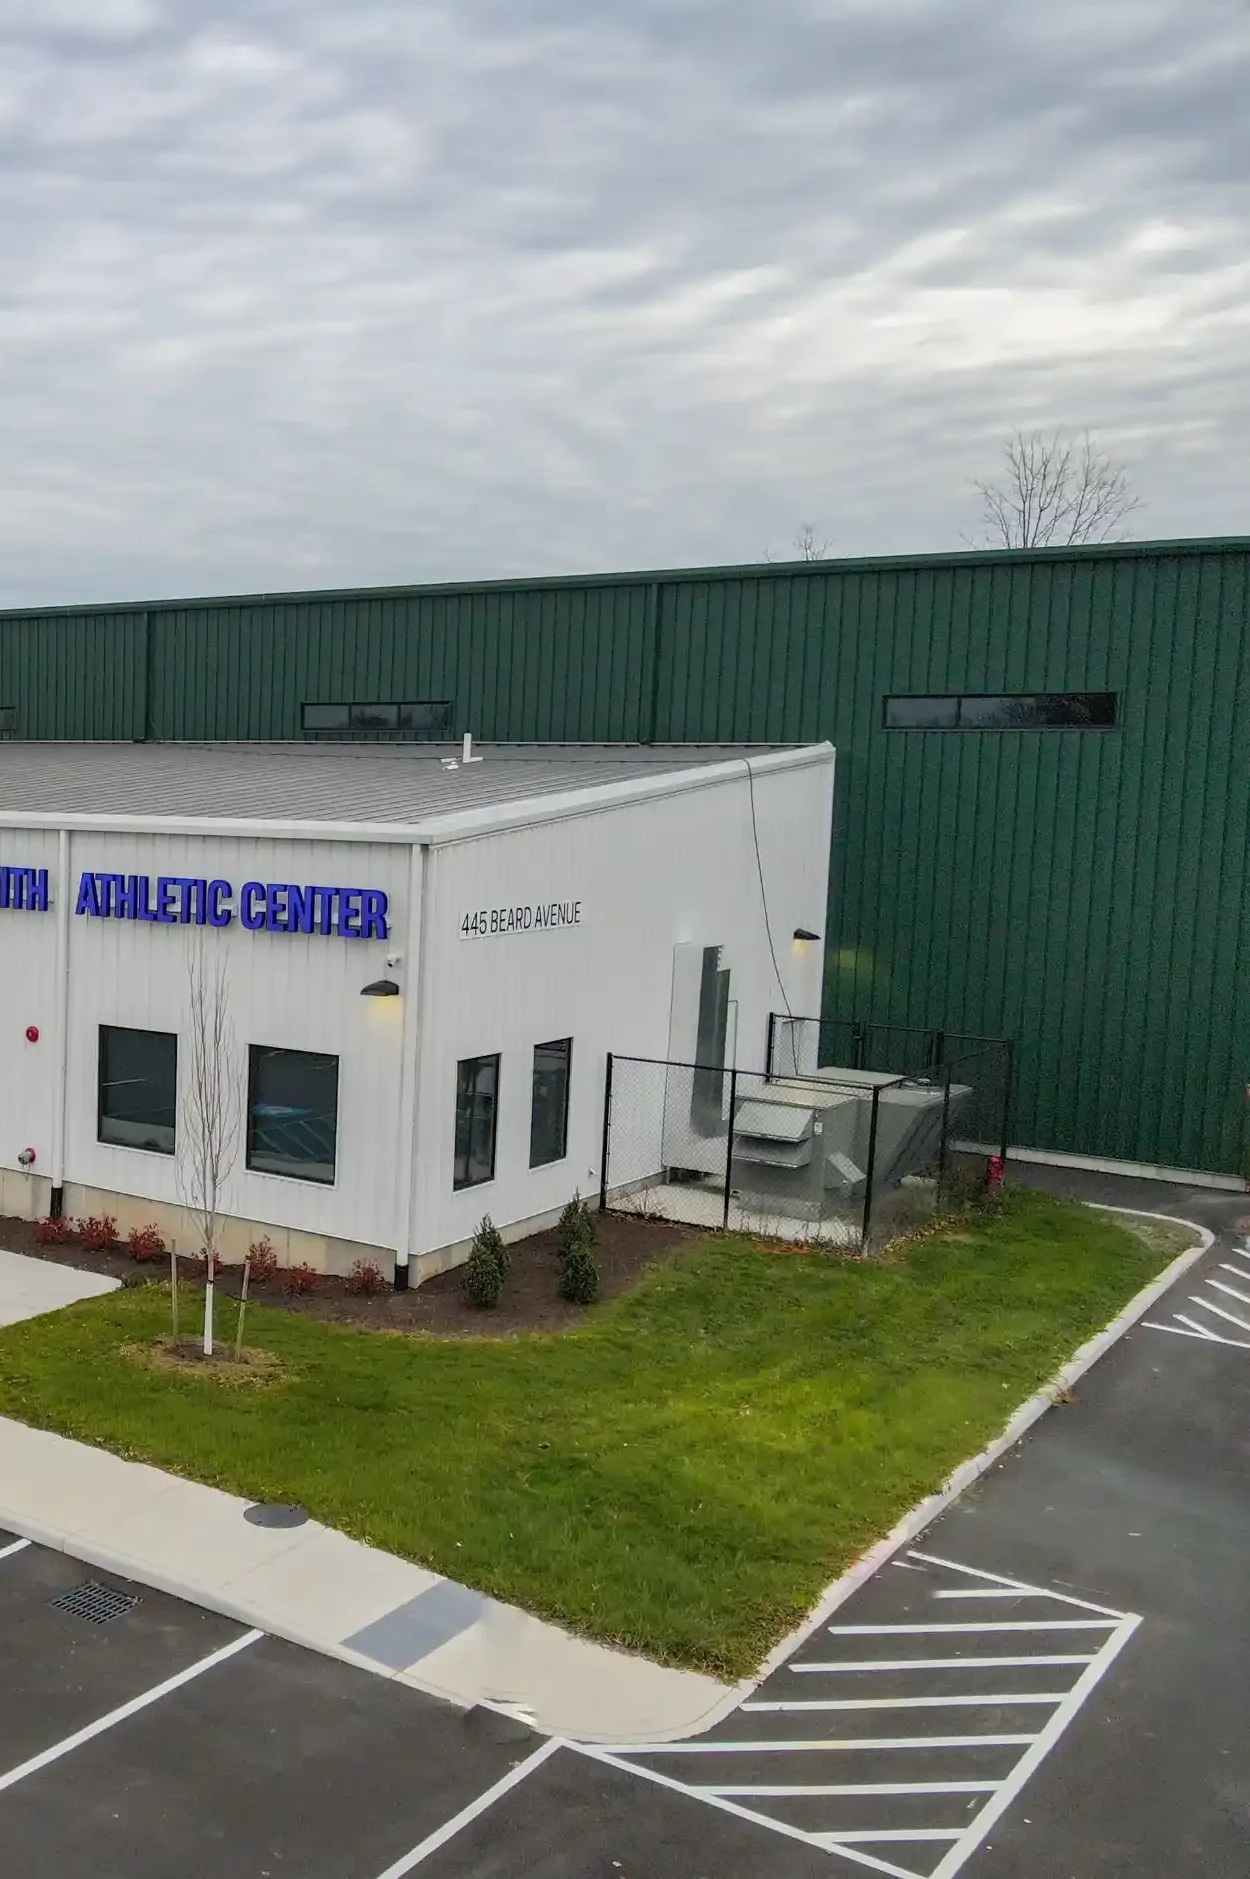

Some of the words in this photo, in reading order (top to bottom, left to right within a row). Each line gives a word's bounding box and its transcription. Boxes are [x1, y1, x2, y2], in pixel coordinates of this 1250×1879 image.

[75, 872, 232, 927] ATHLETIC
[240, 881, 388, 939] CENTER
[461, 911, 488, 936] 445
[490, 906, 532, 933] BEARD
[534, 901, 581, 928] AVENUE
